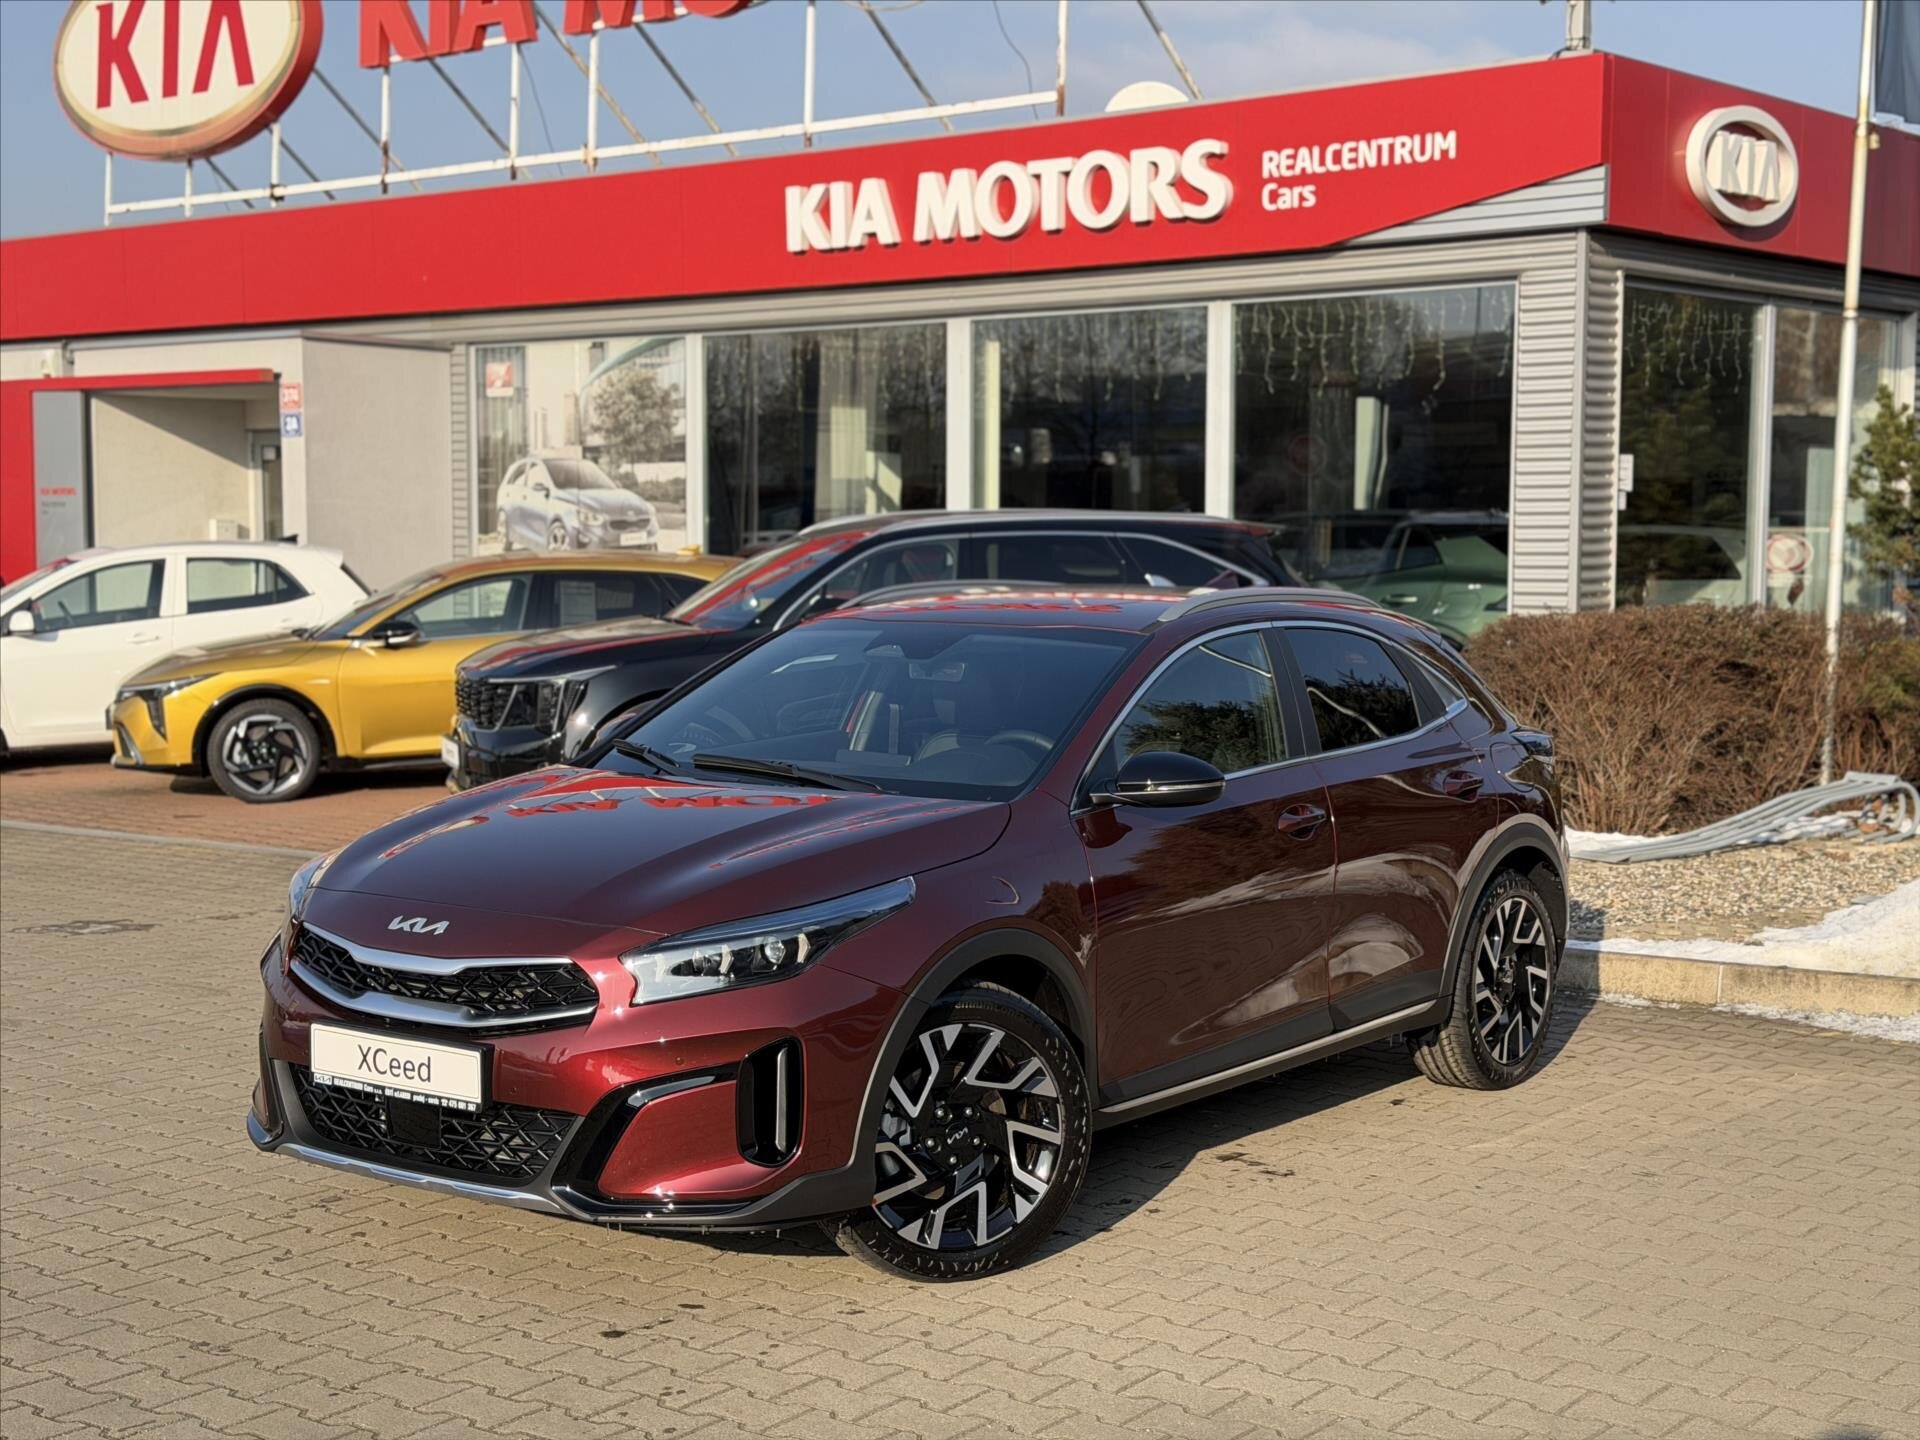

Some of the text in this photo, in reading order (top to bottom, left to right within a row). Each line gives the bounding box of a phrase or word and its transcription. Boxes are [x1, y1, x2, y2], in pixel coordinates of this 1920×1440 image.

[96, 0, 255, 109] KIA
[1262, 130, 1457, 179] REALCENTRUM
[1710, 131, 1781, 201] KIA
[785, 139, 1233, 252] KIA MOTORS
[1262, 183, 1317, 211] Cars
[388, 915, 450, 935] KIA
[357, 1043, 431, 1083] XCeed
